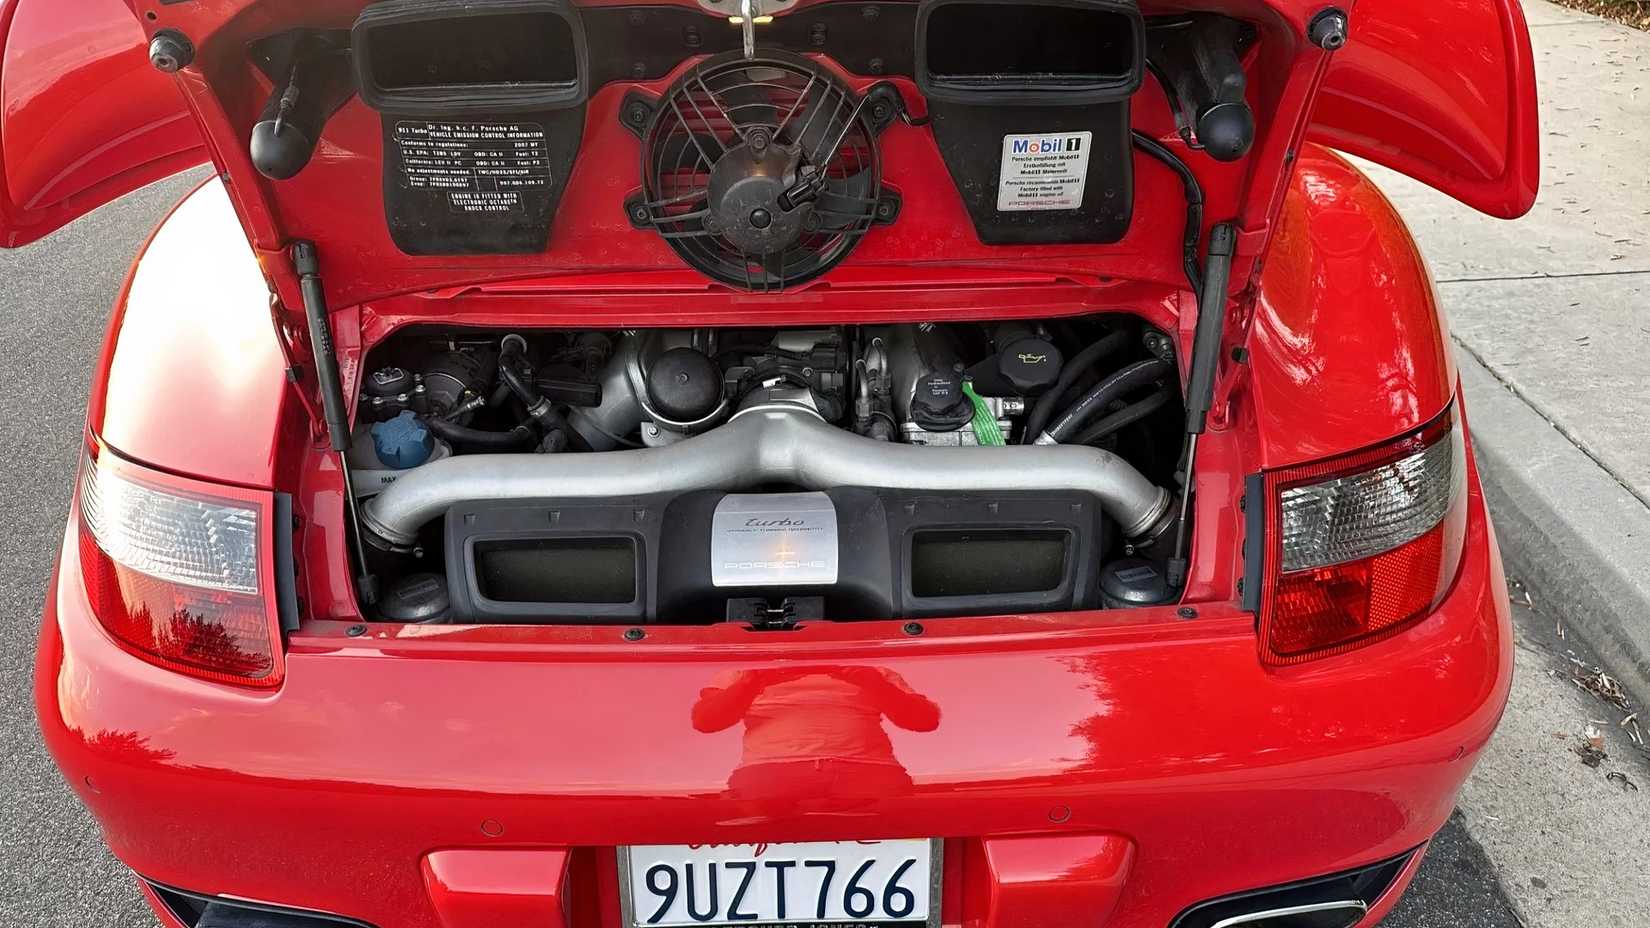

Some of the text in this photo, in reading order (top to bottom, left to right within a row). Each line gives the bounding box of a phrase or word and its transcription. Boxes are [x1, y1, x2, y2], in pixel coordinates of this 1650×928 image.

[1013, 138, 1081, 153] Mobil 1
[380, 476, 397, 484] MAX
[744, 517, 805, 527] turbo
[724, 560, 826, 569] PORSCHE
[645, 858, 918, 924] 9UZT766
